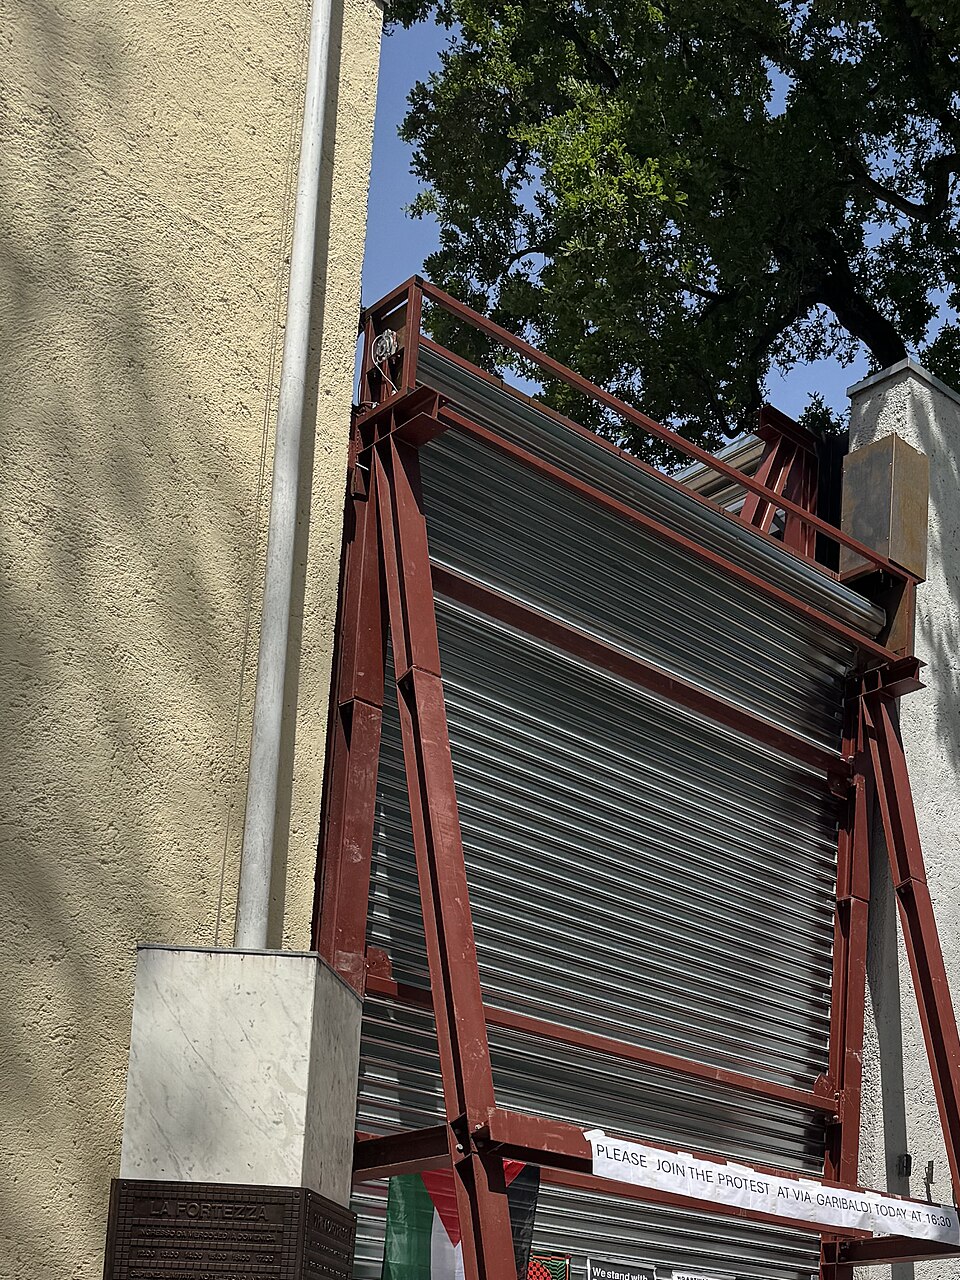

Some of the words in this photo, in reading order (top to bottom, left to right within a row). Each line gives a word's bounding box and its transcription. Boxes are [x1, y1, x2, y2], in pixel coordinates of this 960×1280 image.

[596, 1144, 648, 1168] PLEASE
[656, 1158, 686, 1177] JOIN
[688, 1166, 714, 1183] THE
[718, 1173, 770, 1195] PROTEST
[777, 1186, 790, 1198] AT
[792, 1189, 812, 1204] VIA
[816, 1194, 872, 1214] GARIBALDI
[874, 1204, 907, 1218] TODAY
[911, 1211, 924, 1222] AT
[926, 1213, 951, 1228] 16:30
[150, 1201, 171, 1217] LA
[178, 1202, 269, 1221] FORTEZZA
[592, 1266, 606, 1277] We
